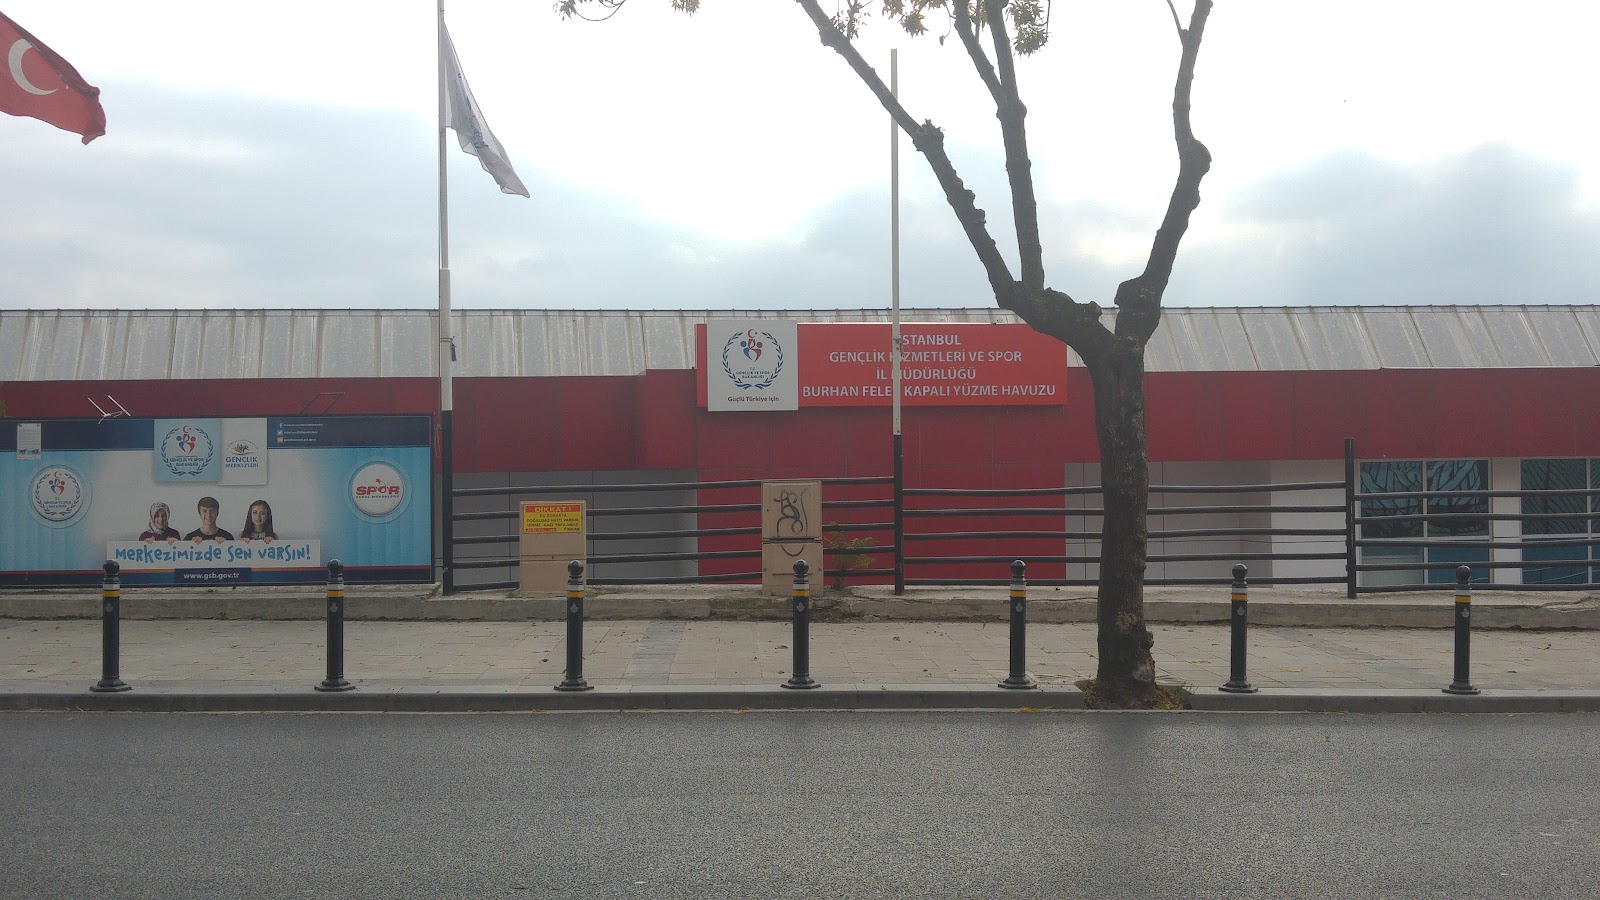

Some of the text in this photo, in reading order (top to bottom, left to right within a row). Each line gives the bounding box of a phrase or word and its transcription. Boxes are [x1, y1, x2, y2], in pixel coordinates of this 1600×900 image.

[829, 348, 886, 365] GENÇLİK
[968, 351, 985, 362] VE
[988, 351, 1022, 362] SPOR
[876, 366, 976, 380] İL ÜDÜRLÜĞÜ
[802, 383, 1056, 397] BURHAN FELE KAPALI YÜZME HAVUZU
[356, 486, 400, 495] SPOR
[183, 572, 240, 580] www.gsb.gov.tr
